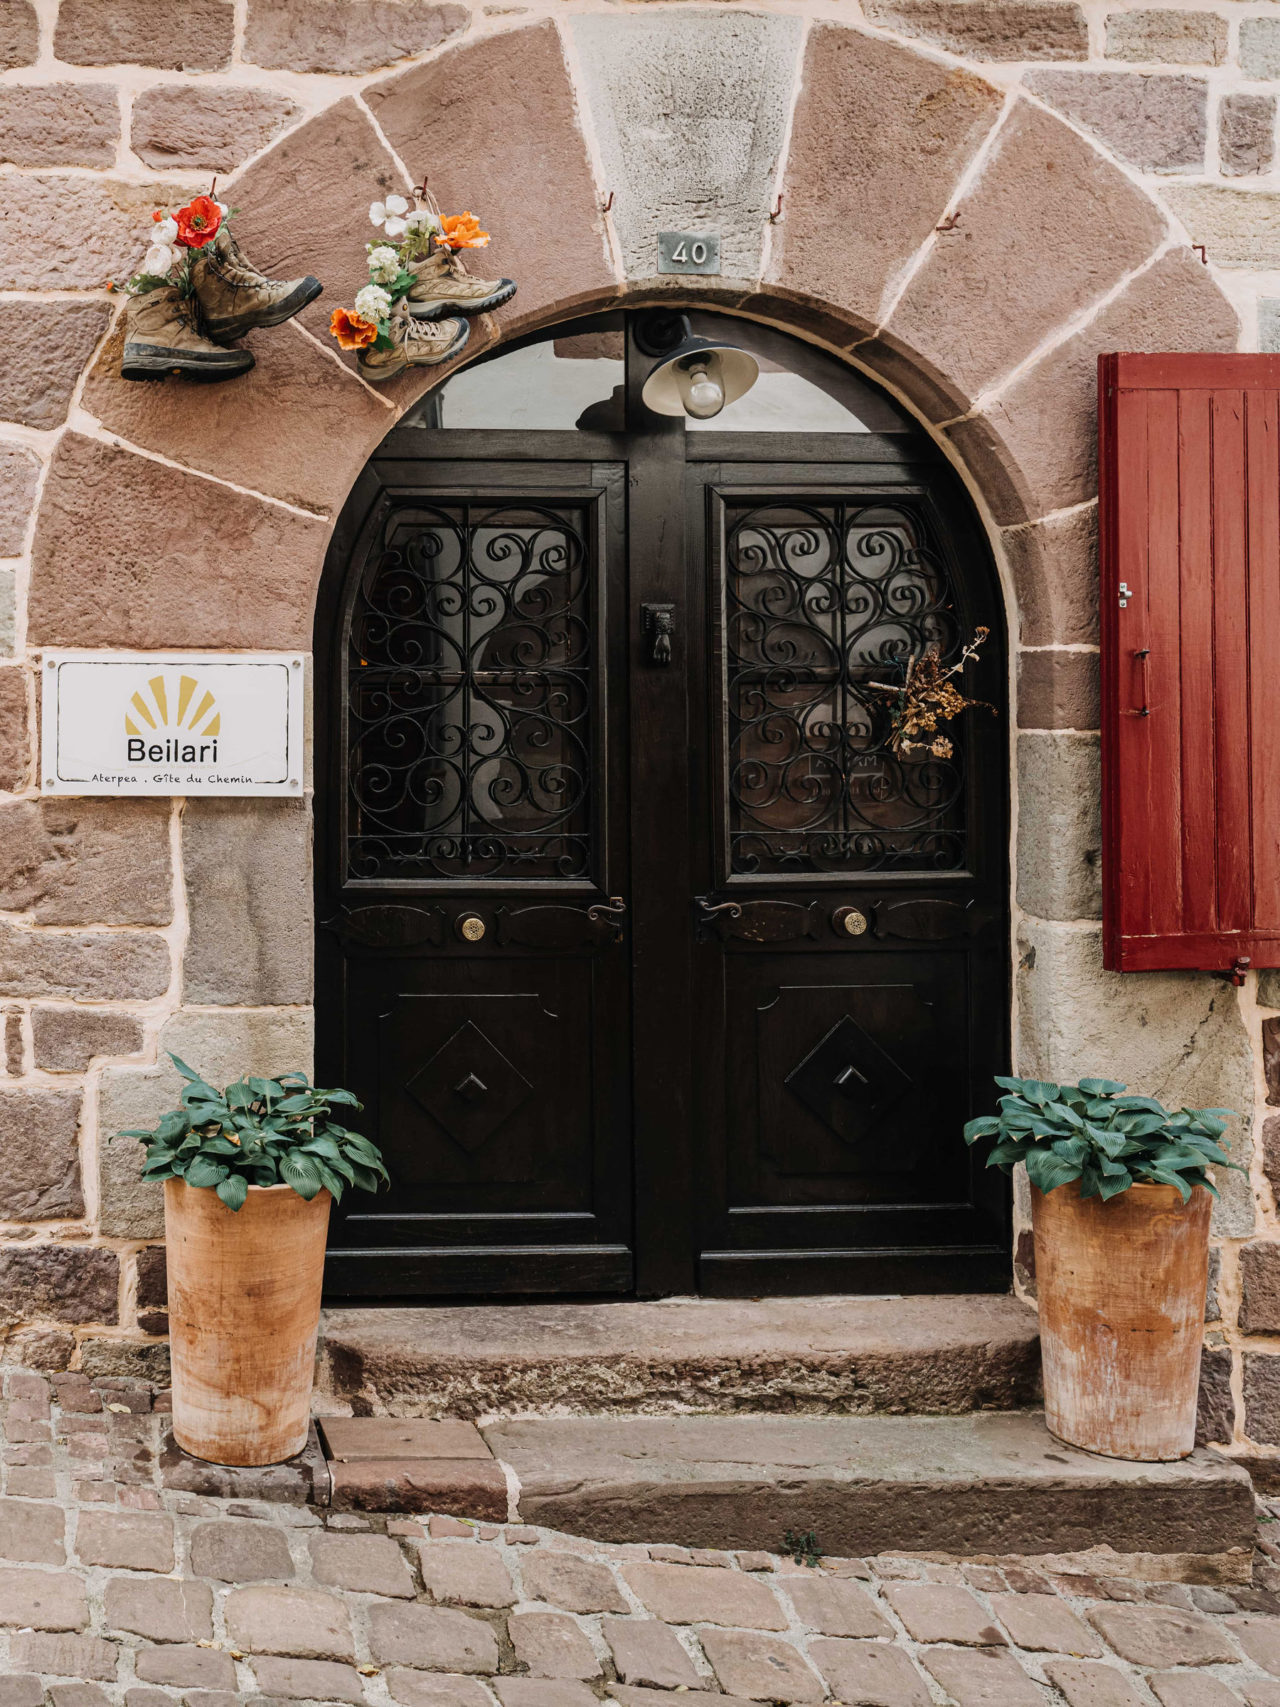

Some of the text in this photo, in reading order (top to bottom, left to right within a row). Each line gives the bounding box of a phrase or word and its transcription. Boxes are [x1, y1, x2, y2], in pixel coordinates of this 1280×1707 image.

[671, 241, 707, 264] 40
[127, 738, 218, 763] Beilari
[91, 773, 138, 788] Aterpea
[152, 773, 182, 784] Gîte
[186, 774, 202, 784] du
[208, 774, 253, 784] Chemin
